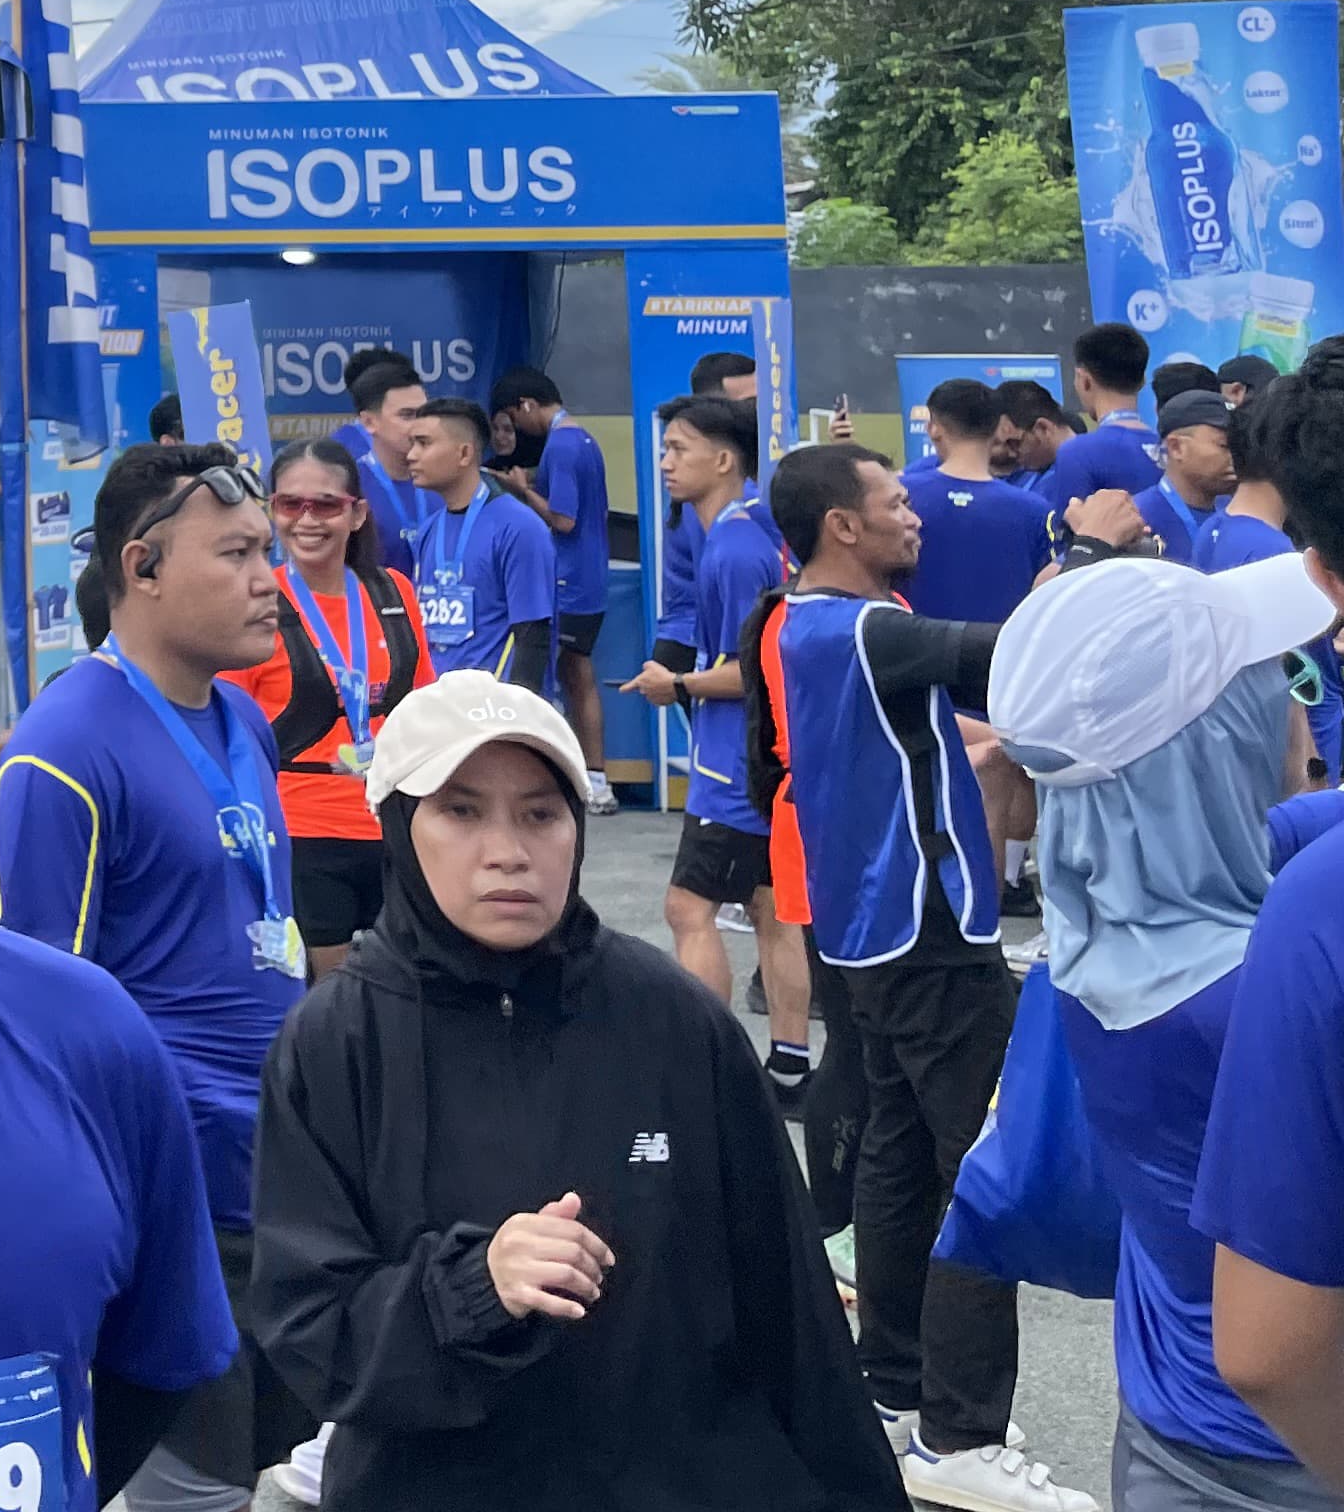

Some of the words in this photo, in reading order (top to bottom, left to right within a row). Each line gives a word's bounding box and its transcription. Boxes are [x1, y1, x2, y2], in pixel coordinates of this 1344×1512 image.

[209, 128, 294, 140] MINUMAN
[303, 127, 389, 139] ISOTONIK
[207, 146, 576, 219] ISOPLUS
[1173, 122, 1223, 251] ISOPLUS
[676, 319, 748, 334] MINUM
[263, 338, 476, 397] ISOUS
[467, 698, 517, 721] alo
